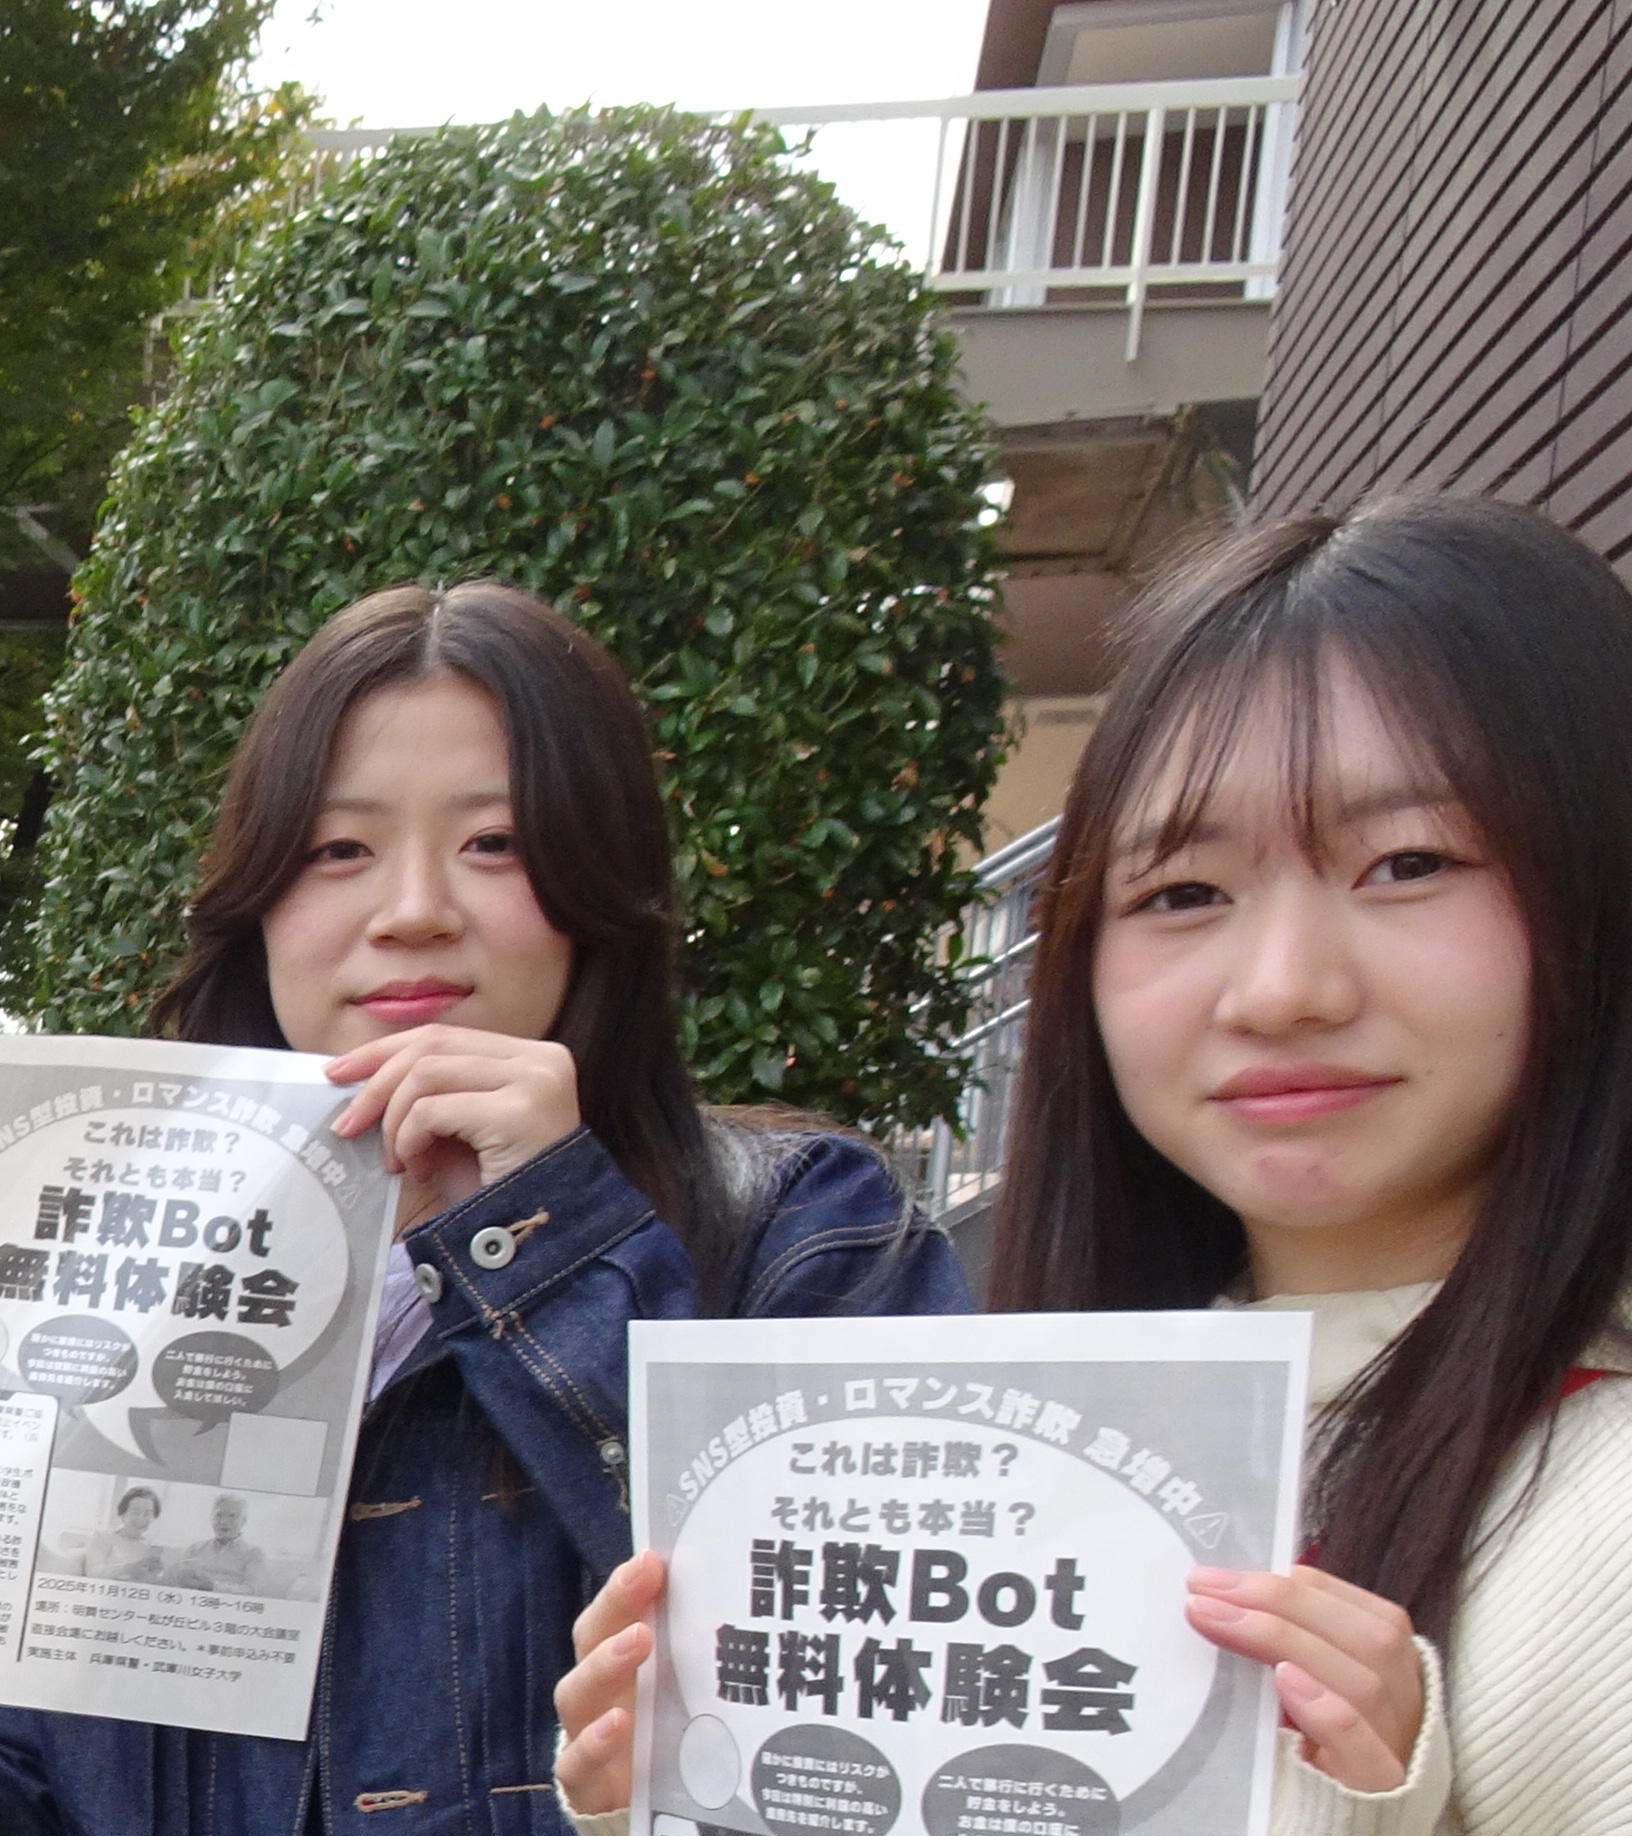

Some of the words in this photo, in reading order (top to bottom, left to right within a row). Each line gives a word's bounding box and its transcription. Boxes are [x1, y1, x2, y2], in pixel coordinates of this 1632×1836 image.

[33, 1185, 274, 1258] 詐欺Bot
[678, 1377, 1080, 1502] SNS型投資・ロマンス詐欺
[1083, 1423, 1202, 1513] 急増中
[790, 1442, 1018, 1479] これは詐欺？
[771, 1497, 1035, 1537] それとも本当？
[749, 1539, 1086, 1631] 詐欺Bot
[714, 1624, 1138, 1735] 無料体験会
